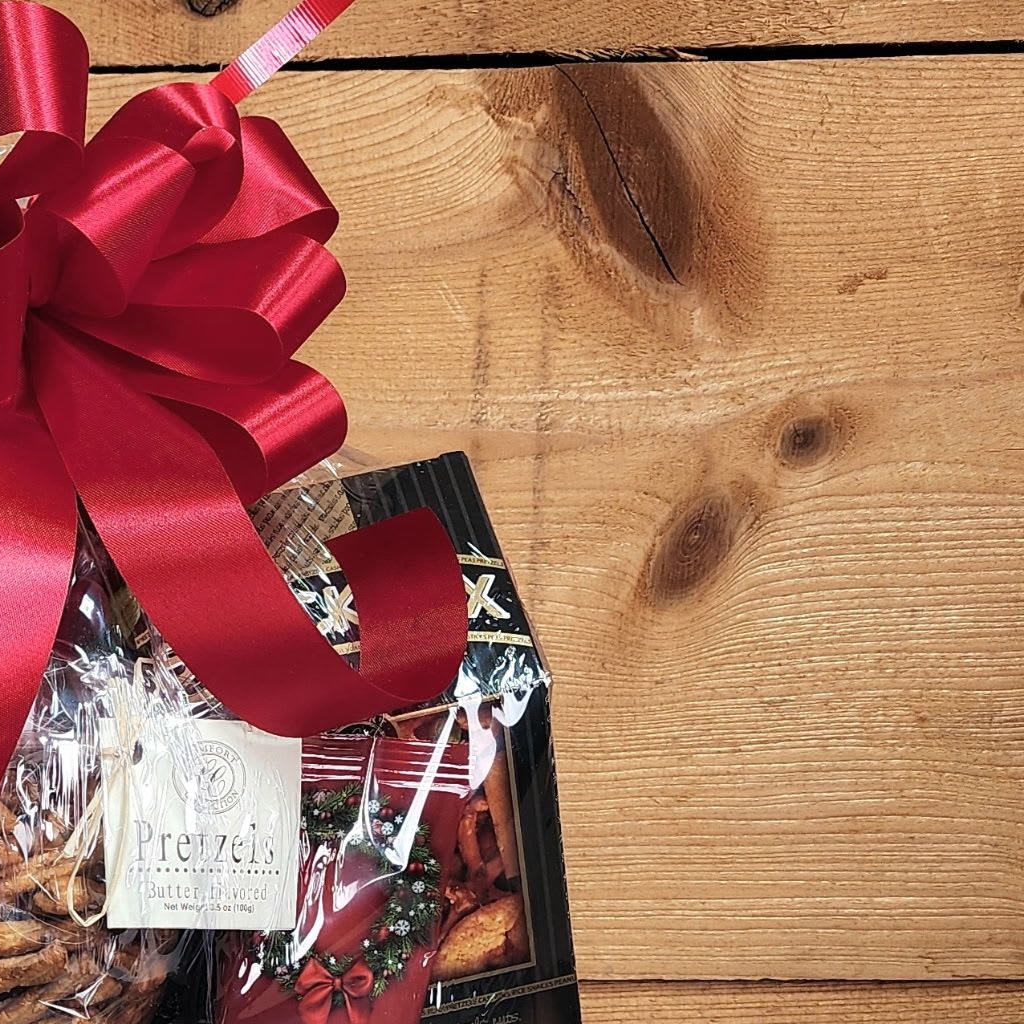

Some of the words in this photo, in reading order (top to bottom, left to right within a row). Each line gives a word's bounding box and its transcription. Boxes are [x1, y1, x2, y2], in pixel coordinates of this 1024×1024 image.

[133, 819, 275, 865] Pretzels
[147, 881, 200, 900] Butter
[163, 902, 179, 912] Net
[222, 904, 232, 912] oz
[233, 903, 256, 914] (100g)
